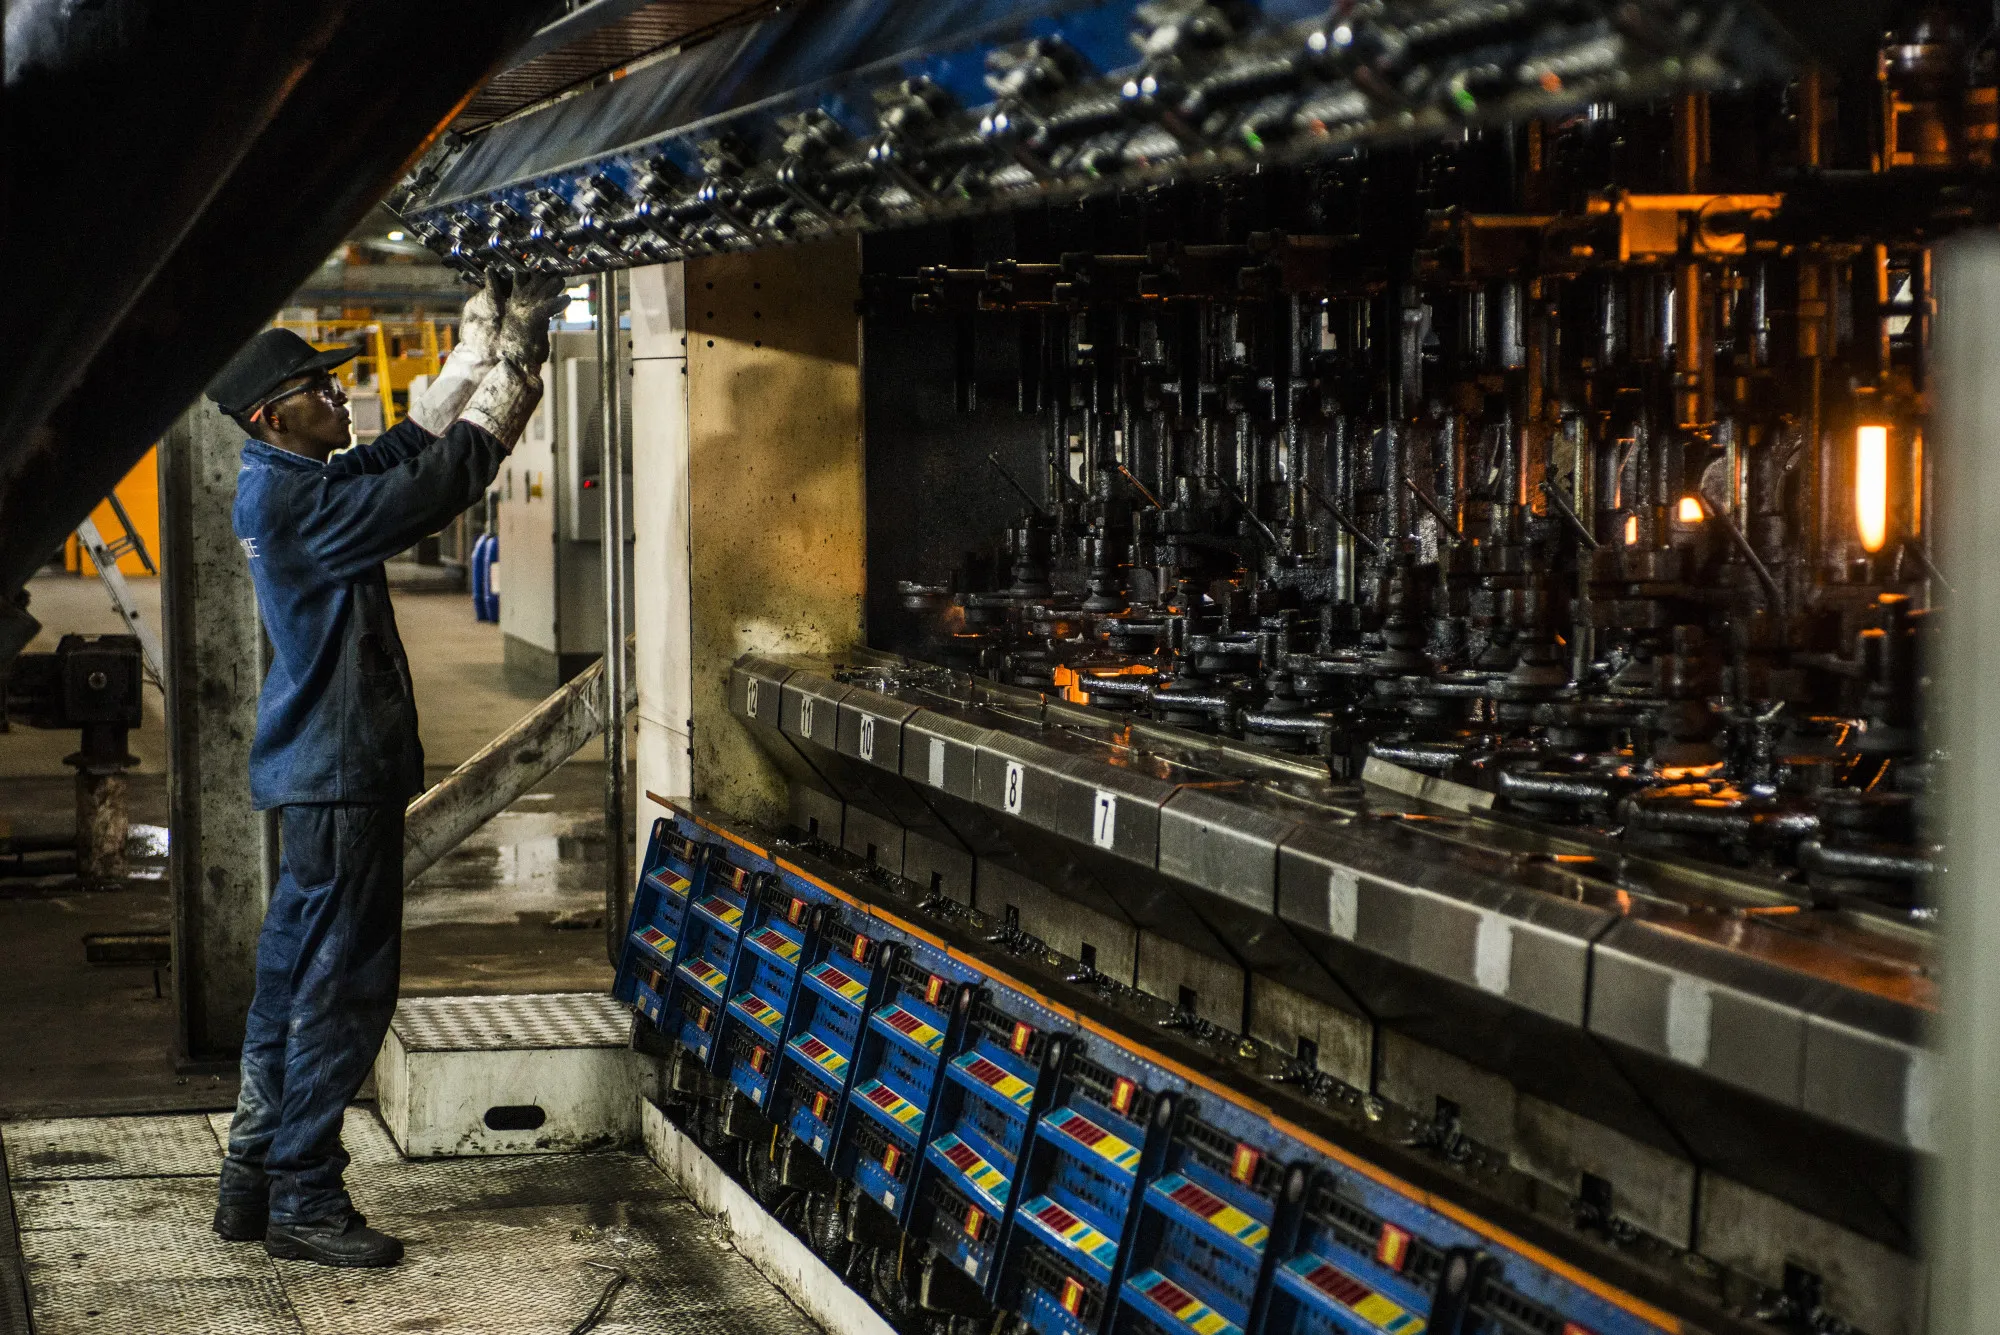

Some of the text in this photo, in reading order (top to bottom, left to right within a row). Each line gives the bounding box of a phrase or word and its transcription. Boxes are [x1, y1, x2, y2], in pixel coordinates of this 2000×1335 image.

[749, 680, 757, 713] 12
[802, 699, 811, 736] 11
[862, 719, 871, 756] 10
[1010, 769, 1017, 807] 8
[1101, 799, 1108, 840] 7
